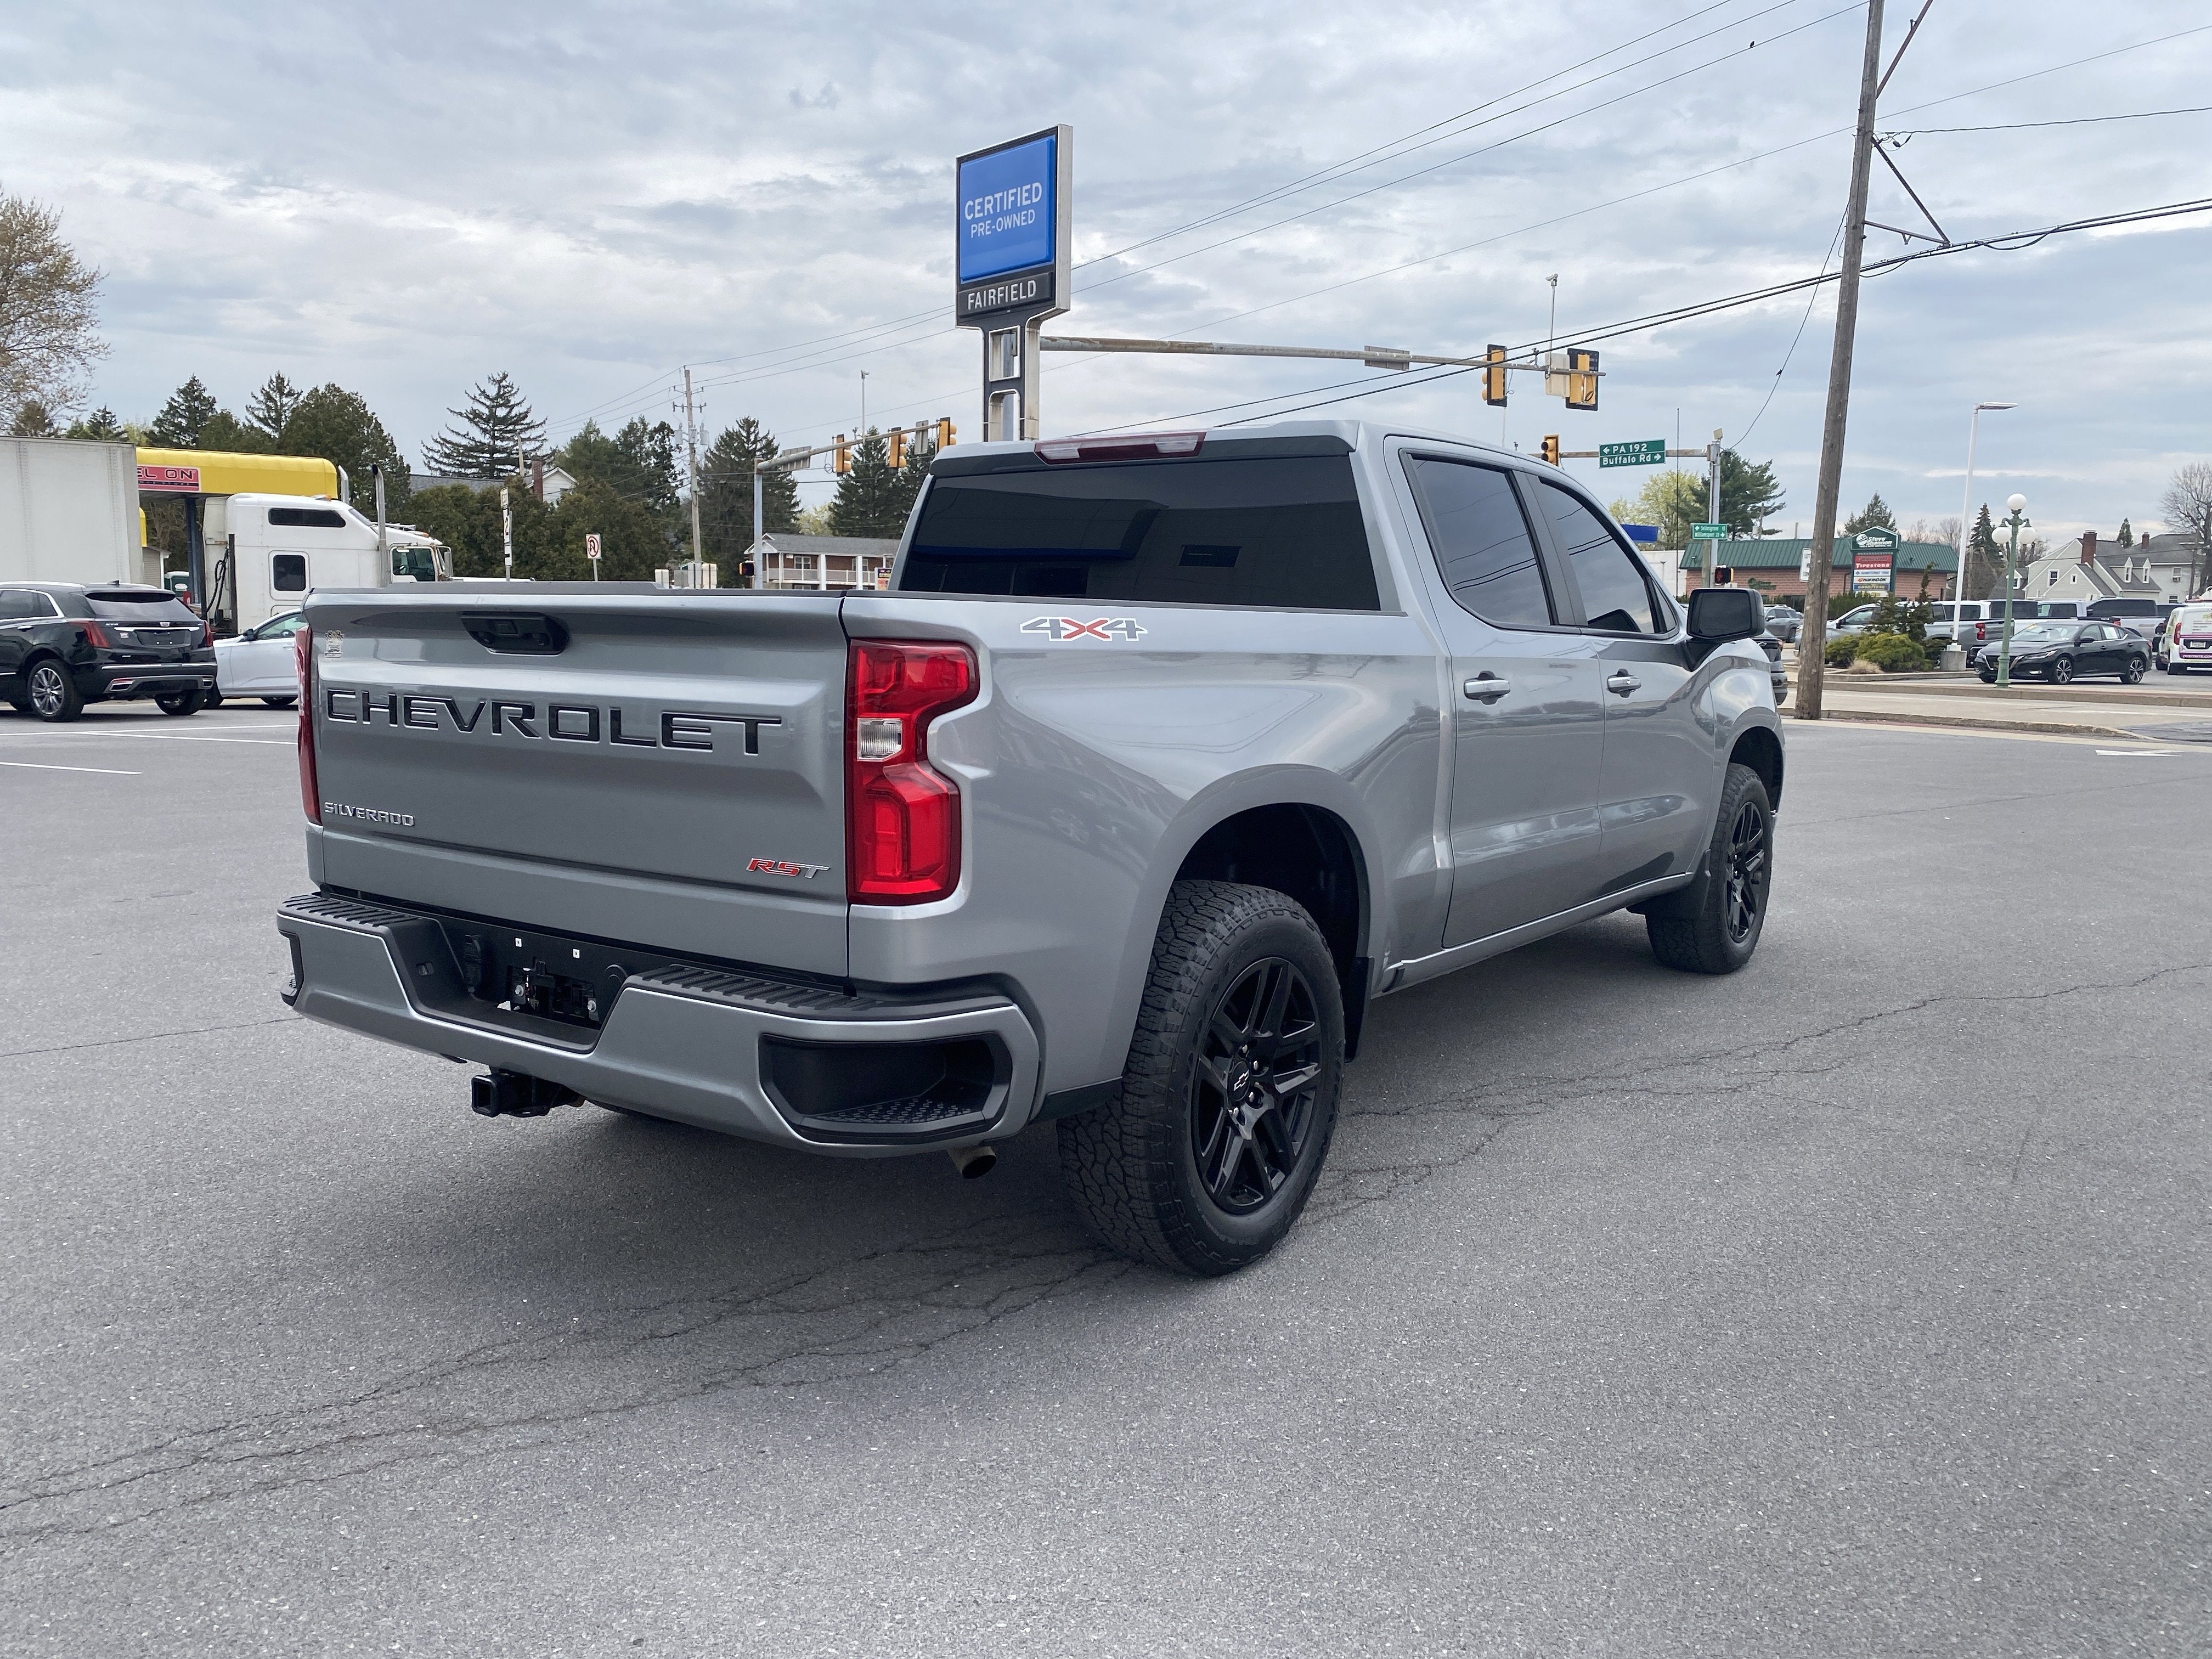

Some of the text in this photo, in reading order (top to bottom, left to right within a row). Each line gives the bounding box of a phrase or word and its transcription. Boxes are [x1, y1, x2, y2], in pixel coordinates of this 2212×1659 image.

[964, 182, 1042, 220] CERTIFIED
[970, 209, 1035, 238] PRE-OWNED
[968, 280, 1037, 311] FAIRFIELD
[1602, 454, 1651, 465] Buffalo Rd
[1613, 443, 1647, 454] PA 192
[165, 469, 193, 479] ON
[1020, 616, 1148, 641] 4X4
[327, 688, 782, 756] CHEVROLET
[324, 802, 415, 827] SILVERADO
[747, 857, 830, 878] RST
